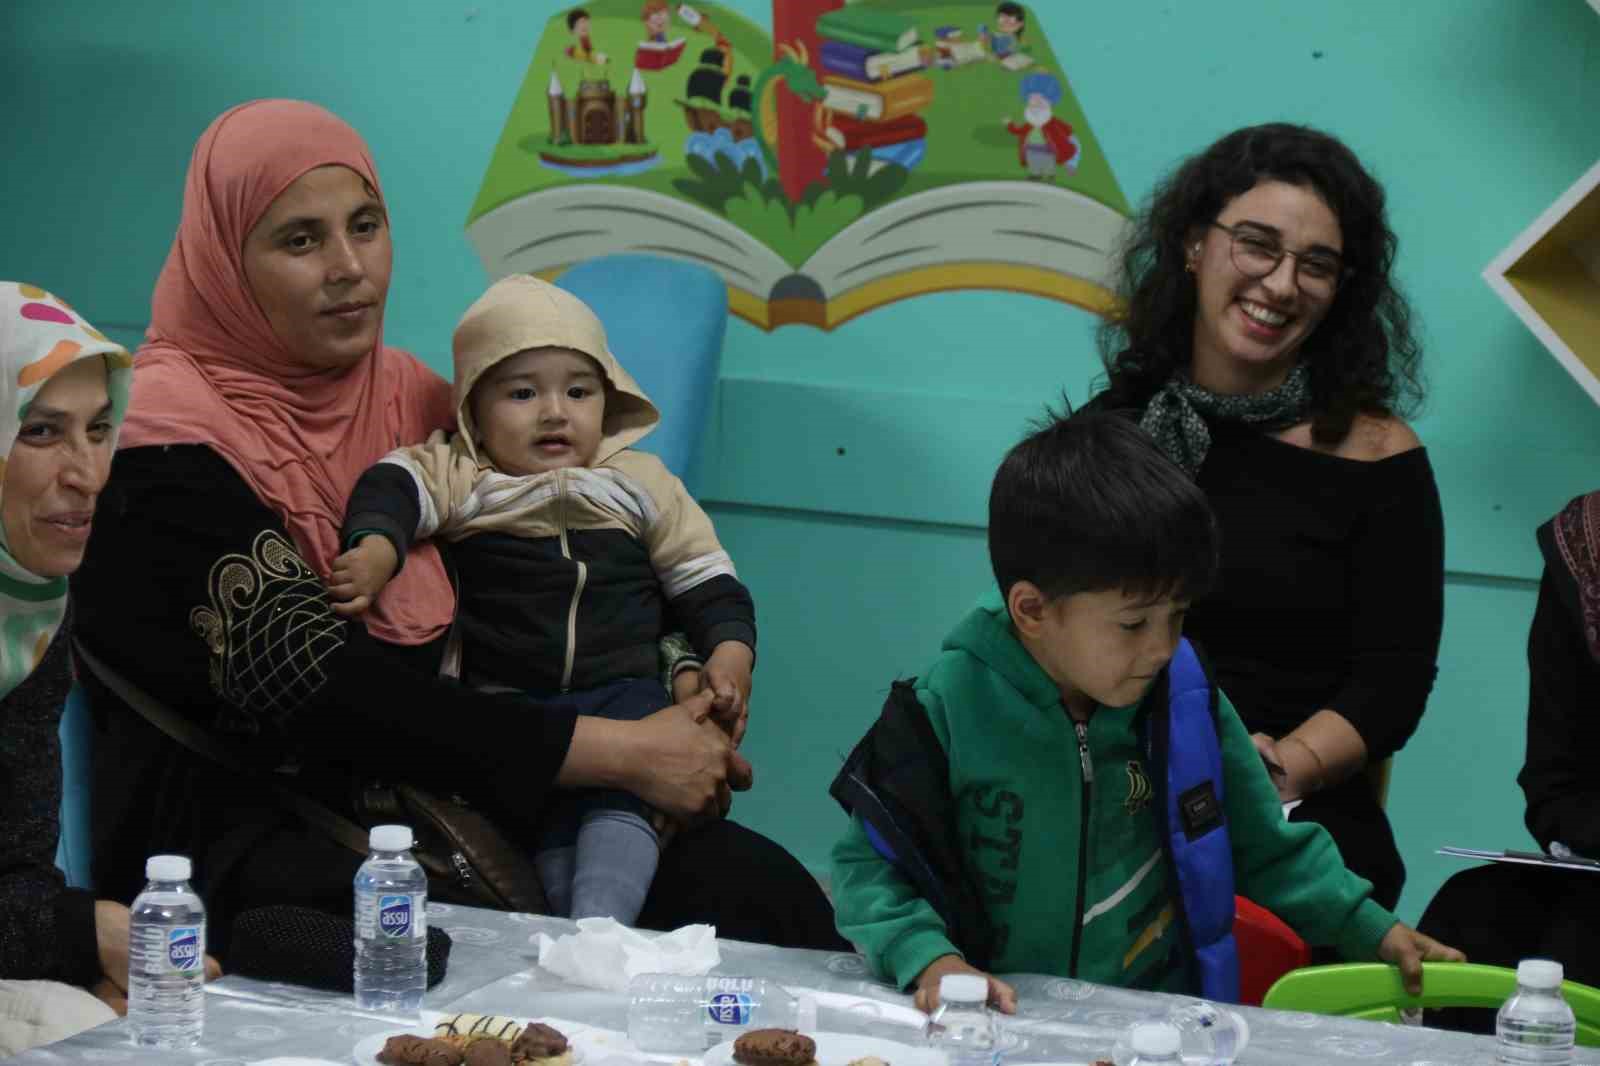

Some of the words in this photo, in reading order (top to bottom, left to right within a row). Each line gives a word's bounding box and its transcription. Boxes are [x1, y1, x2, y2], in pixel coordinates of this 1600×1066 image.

[382, 911, 409, 926] assu
[171, 944, 197, 960] assu
[719, 995, 736, 1022] assu
